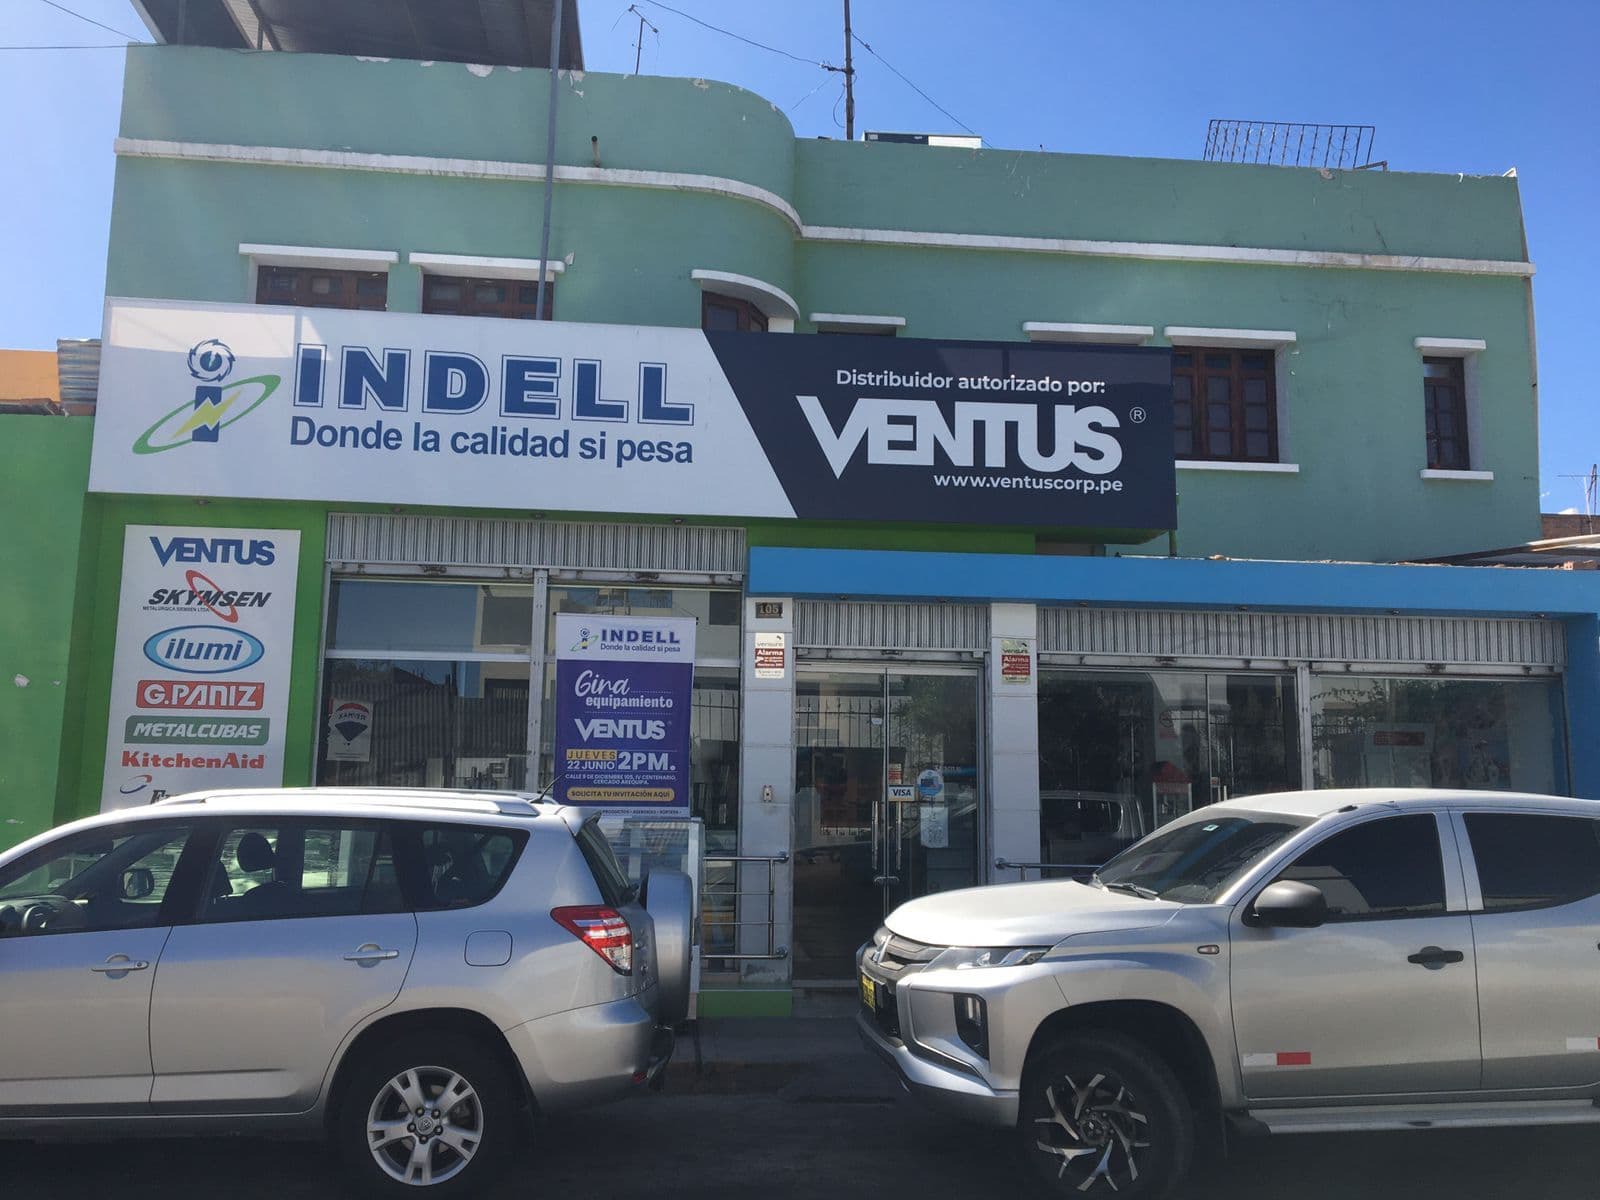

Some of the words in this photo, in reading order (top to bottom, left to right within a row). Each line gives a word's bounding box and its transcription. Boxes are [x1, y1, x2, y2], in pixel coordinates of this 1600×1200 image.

[293, 342, 695, 426] INDELL
[836, 368, 954, 390] Distribuidor
[958, 373, 1063, 393] autorizado
[1067, 378, 1106, 397] por:
[290, 415, 402, 452] Donde
[412, 421, 440, 453] la
[450, 423, 570, 460] calidad
[578, 430, 607, 461] si
[616, 438, 694, 468] pesa
[795, 395, 1123, 480] VENTUS
[933, 473, 1124, 494] www.ventuscorp.pe
[150, 536, 276, 567] VENTUS
[148, 588, 273, 608] SKYMSEN
[601, 628, 680, 644] INDELL
[164, 637, 244, 661] ilumi
[600, 643, 623, 651] Donde
[623, 643, 631, 651] la
[631, 644, 656, 652] calidad
[664, 646, 681, 654] pesa
[574, 669, 631, 697] Gira
[143, 683, 258, 708] G.PANIZ
[585, 695, 674, 709] equipamiento
[132, 721, 262, 740] METALCUBAS
[574, 719, 666, 742] VENTUS
[121, 750, 266, 769] KitchenAid
[567, 750, 617, 760] JUEVES
[567, 760, 580, 770] 22
[581, 761, 616, 770] JUNIO
[617, 751, 677, 771] 2PM.
[571, 790, 604, 798] SOLICITA
[603, 790, 612, 798] TU
[612, 790, 652, 799] INVITACIÓN
[892, 788, 912, 797] VISA
